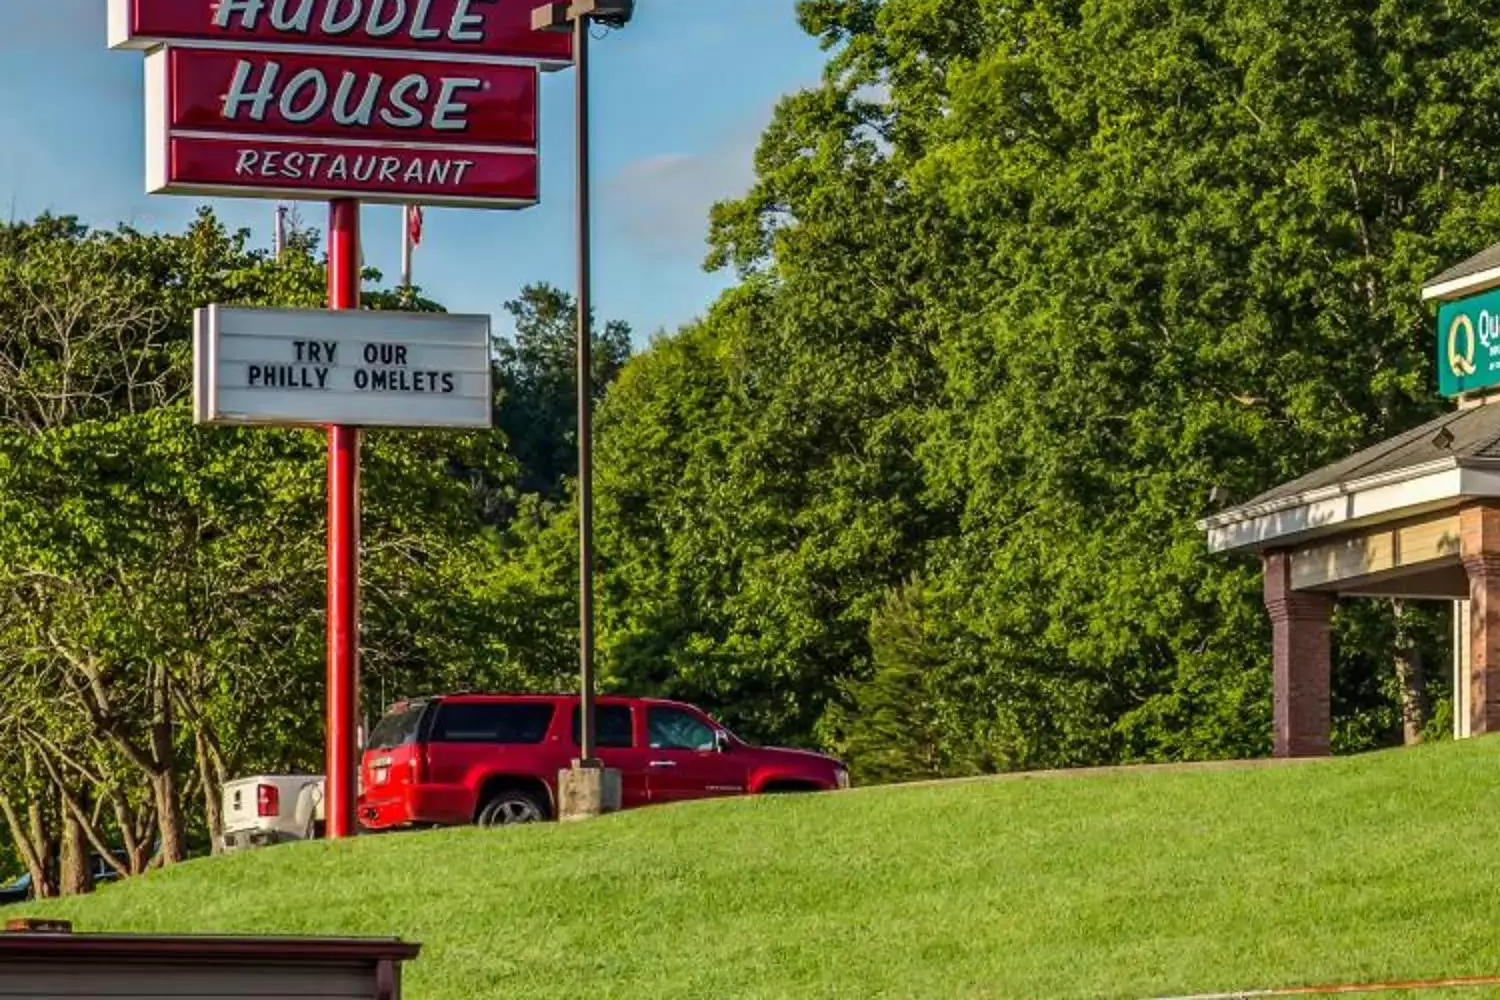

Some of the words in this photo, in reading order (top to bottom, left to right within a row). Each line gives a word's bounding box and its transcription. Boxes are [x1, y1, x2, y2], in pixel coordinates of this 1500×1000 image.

[220, 59, 481, 129] HOUSE
[235, 149, 474, 185] RESTAURANT
[293, 340, 338, 366] TRY
[363, 342, 408, 366] OUR
[1447, 313, 1477, 377] Q
[247, 363, 329, 391] PHILLY
[353, 367, 455, 394] OMELETS
